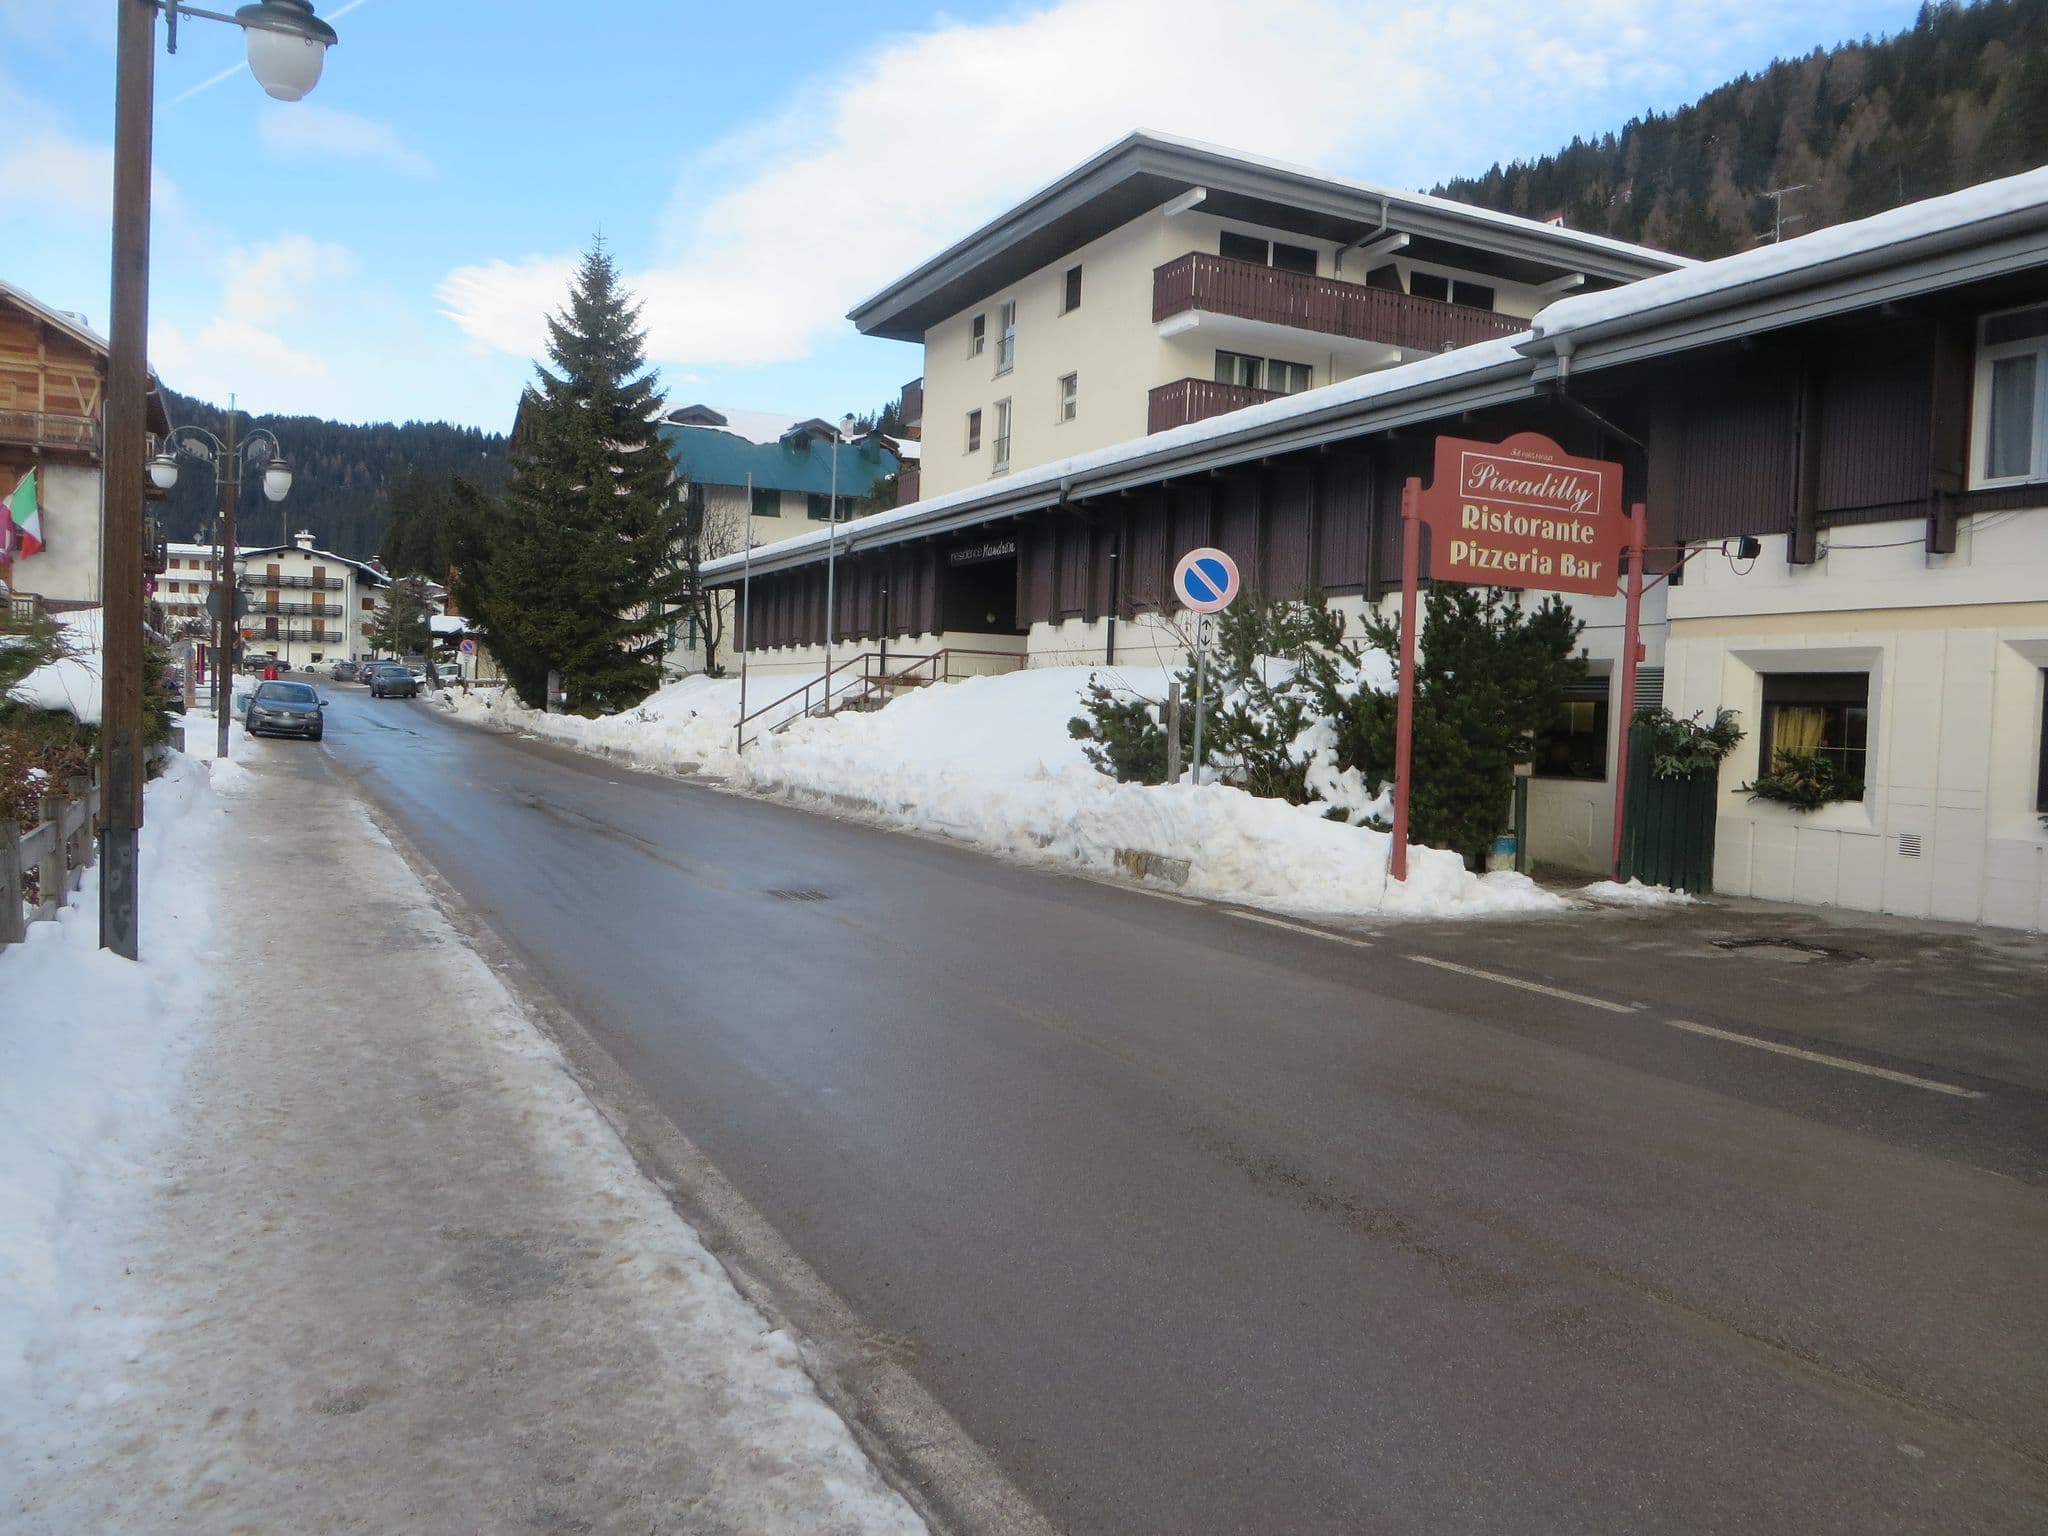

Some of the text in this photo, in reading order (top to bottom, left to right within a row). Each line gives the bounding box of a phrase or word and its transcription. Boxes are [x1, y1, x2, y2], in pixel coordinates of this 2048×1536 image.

[1468, 461, 1592, 513] Piccadilly
[1461, 504, 1595, 544] Ristorante
[1449, 540, 1602, 580] Pizzeria Bar
